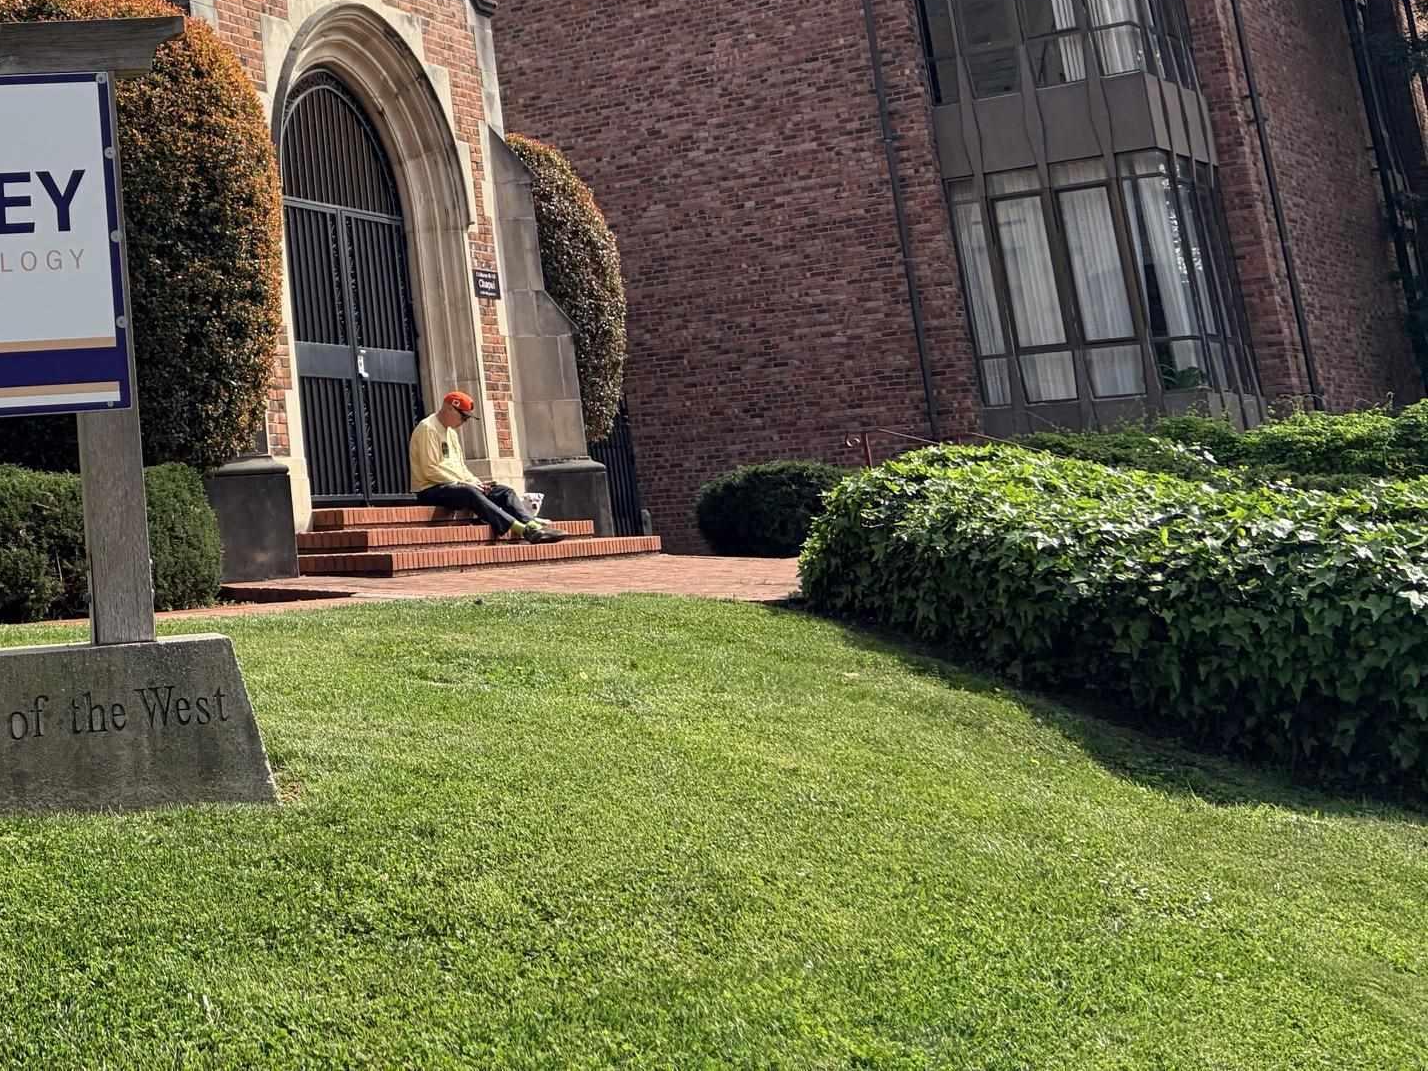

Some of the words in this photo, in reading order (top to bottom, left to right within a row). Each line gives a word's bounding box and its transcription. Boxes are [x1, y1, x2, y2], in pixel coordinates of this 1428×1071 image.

[10, 695, 49, 741] of
[71, 691, 126, 735] the
[134, 686, 230, 729] West
